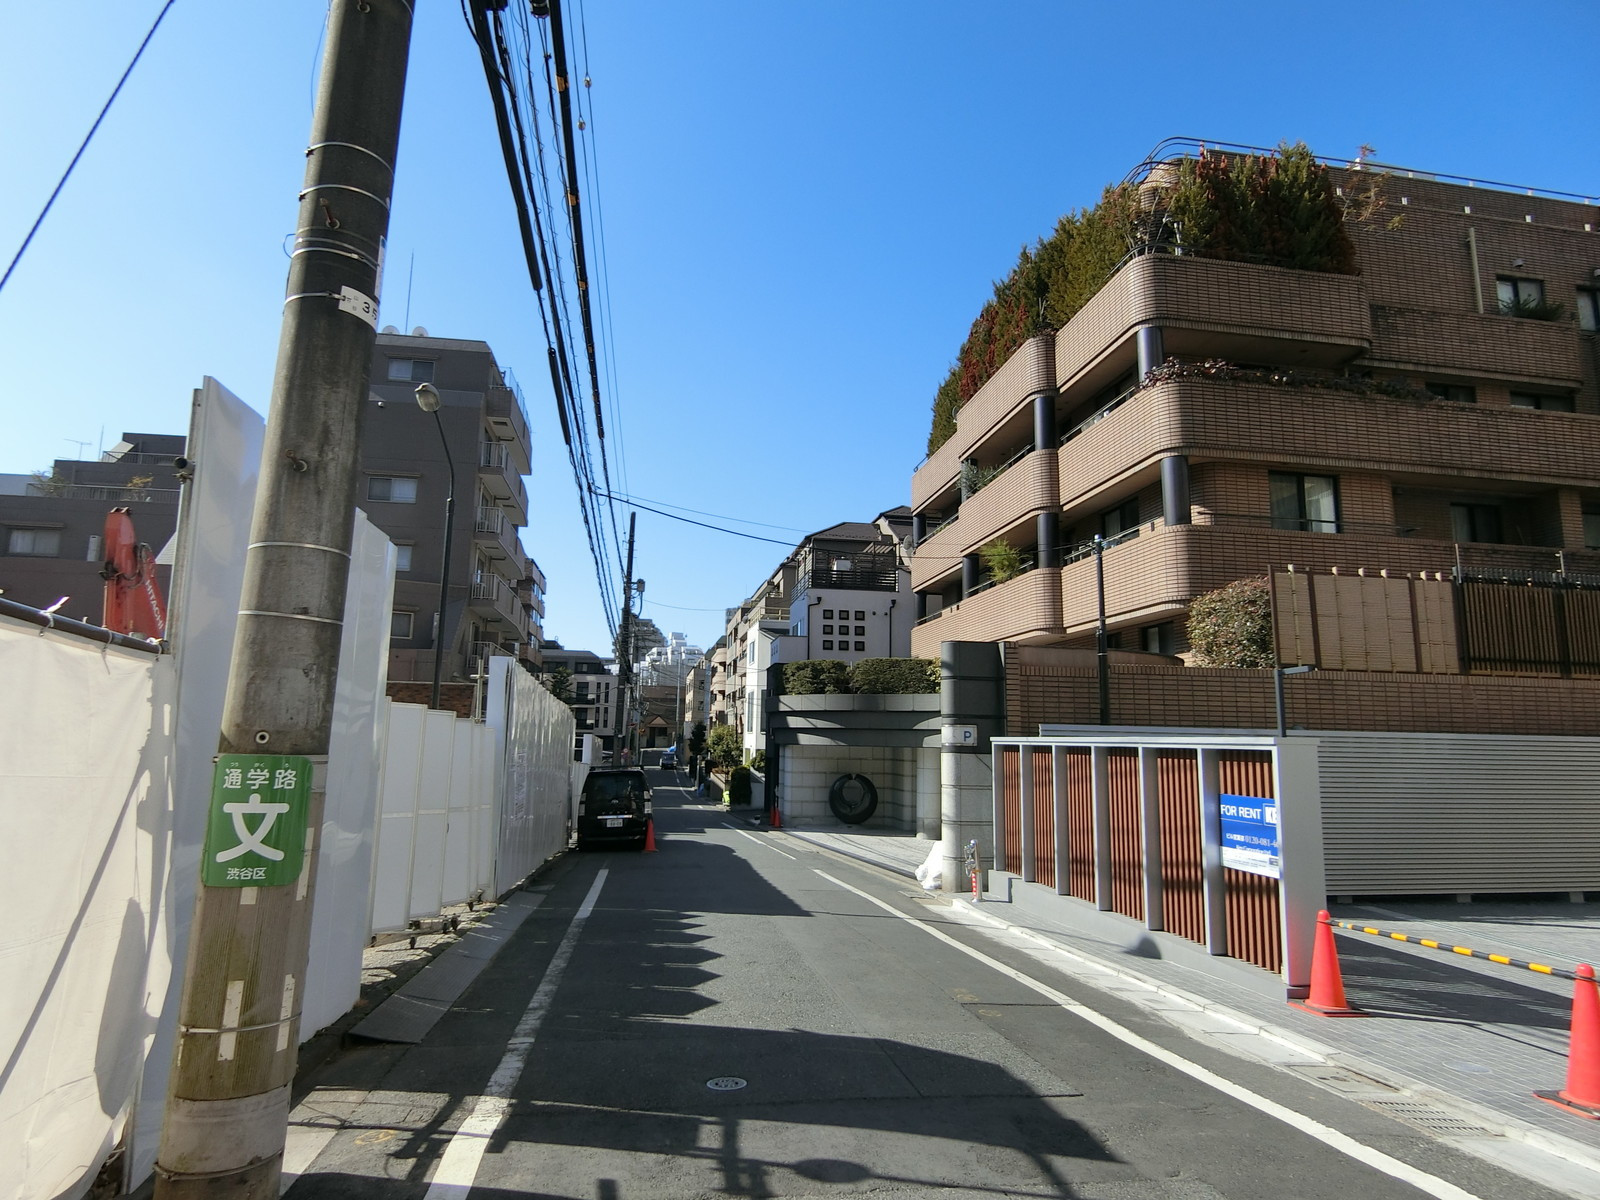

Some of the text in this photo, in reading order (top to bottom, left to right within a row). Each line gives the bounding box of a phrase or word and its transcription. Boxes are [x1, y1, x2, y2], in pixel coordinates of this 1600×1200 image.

[145, 579, 164, 630] HITACHI
[964, 731, 972, 742] P
[223, 768, 297, 789] 通学路
[1220, 804, 1262, 820] FOR RENT
[215, 793, 290, 863] 文
[226, 867, 267, 880] 渋谷区
